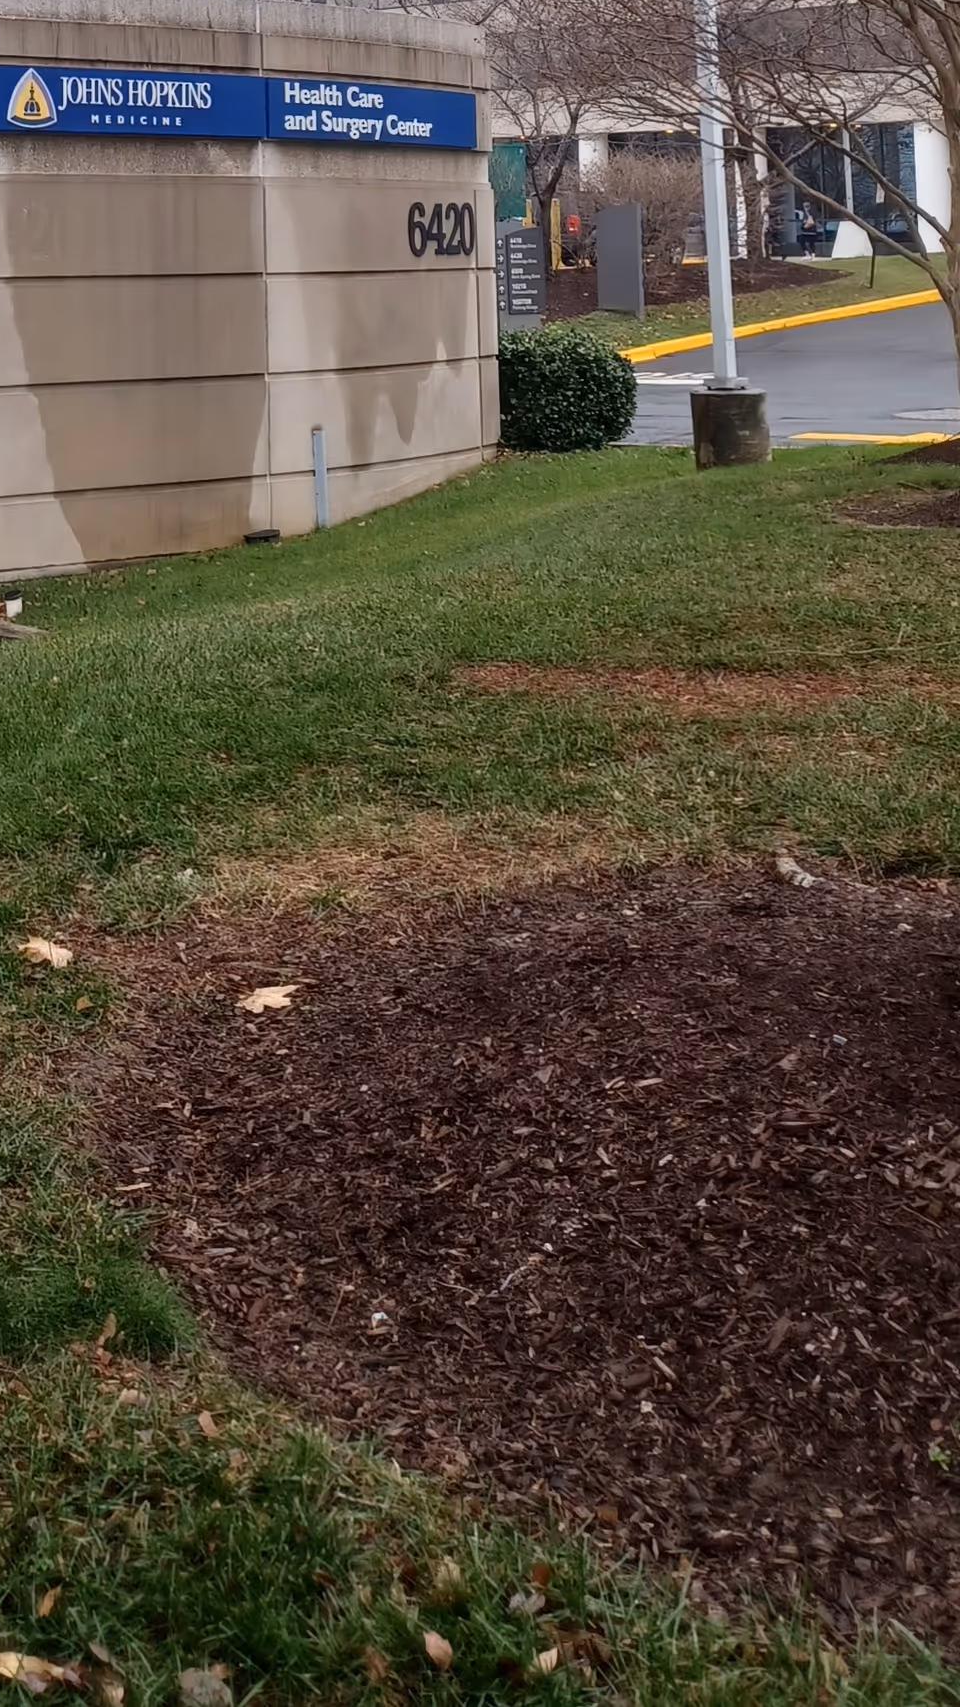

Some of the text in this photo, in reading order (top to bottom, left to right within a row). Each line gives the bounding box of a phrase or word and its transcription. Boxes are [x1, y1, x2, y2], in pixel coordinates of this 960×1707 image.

[58, 76, 212, 111] JOHNS HOPKINS
[284, 82, 383, 109] Health Care
[91, 114, 182, 126] MEDICINE
[284, 109, 433, 140] and Surgery Center
[408, 202, 474, 257] 6420
